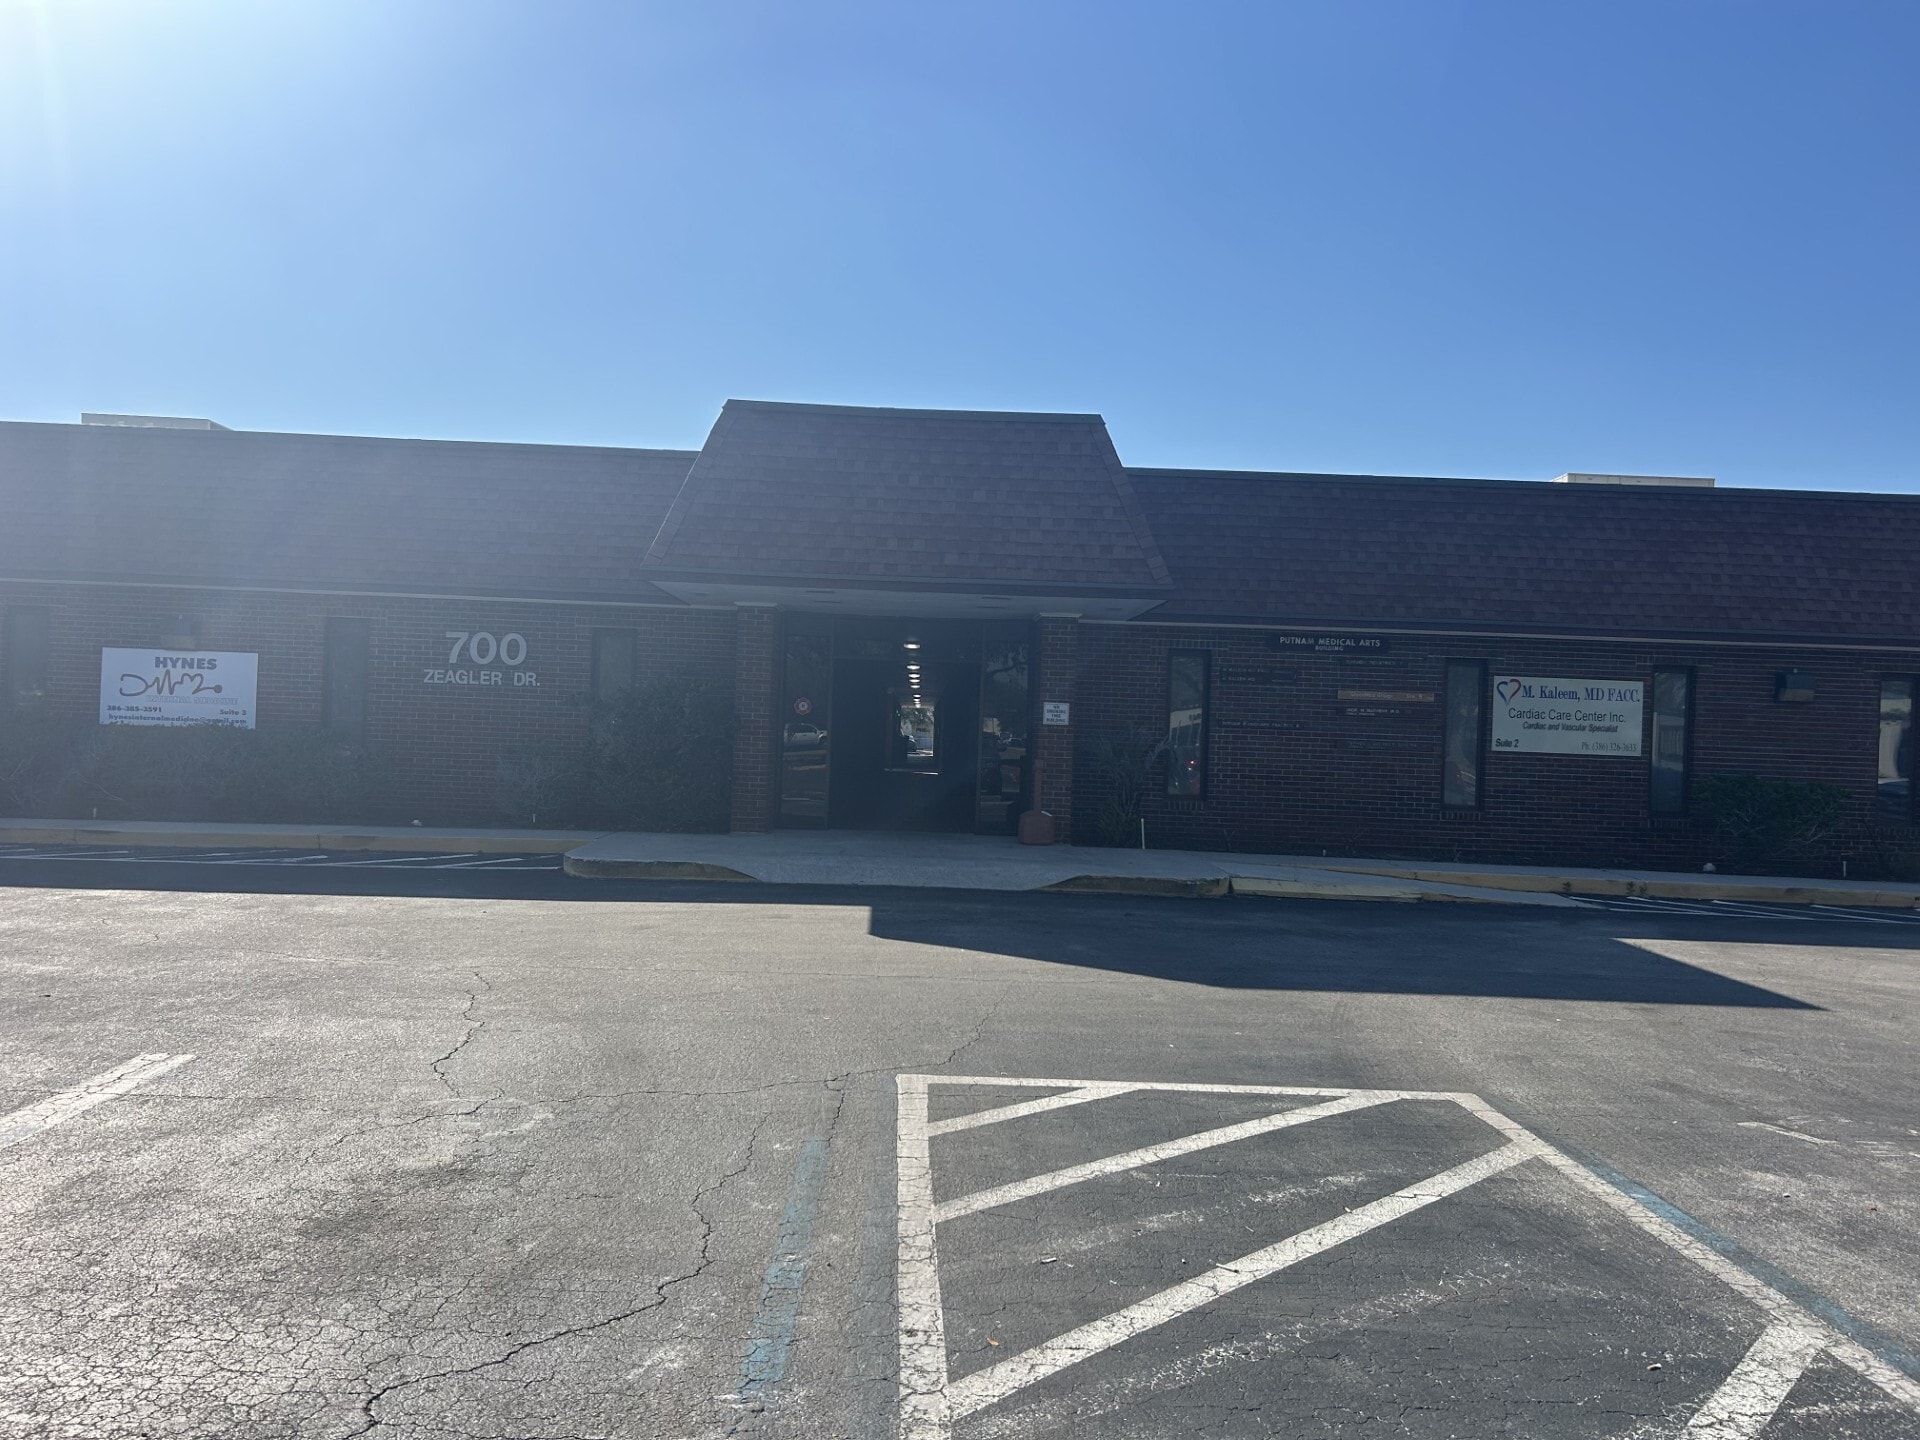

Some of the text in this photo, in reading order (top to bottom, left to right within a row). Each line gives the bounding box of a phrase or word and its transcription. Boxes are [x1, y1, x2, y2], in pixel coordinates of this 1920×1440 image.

[445, 631, 528, 666] 700
[1279, 636, 1381, 647] PUTNAM MEDICAL ARTS
[154, 656, 218, 670] HYNES
[423, 669, 541, 687] ZEAGLER DR.
[1521, 684, 1641, 703] M. Kaleem, MD FACC.
[1508, 707, 1627, 723] Cardiac Care Center Inc.
[1522, 721, 1619, 733] Cardiac and Vascular Specialist
[1495, 738, 1519, 748] Suite 2
